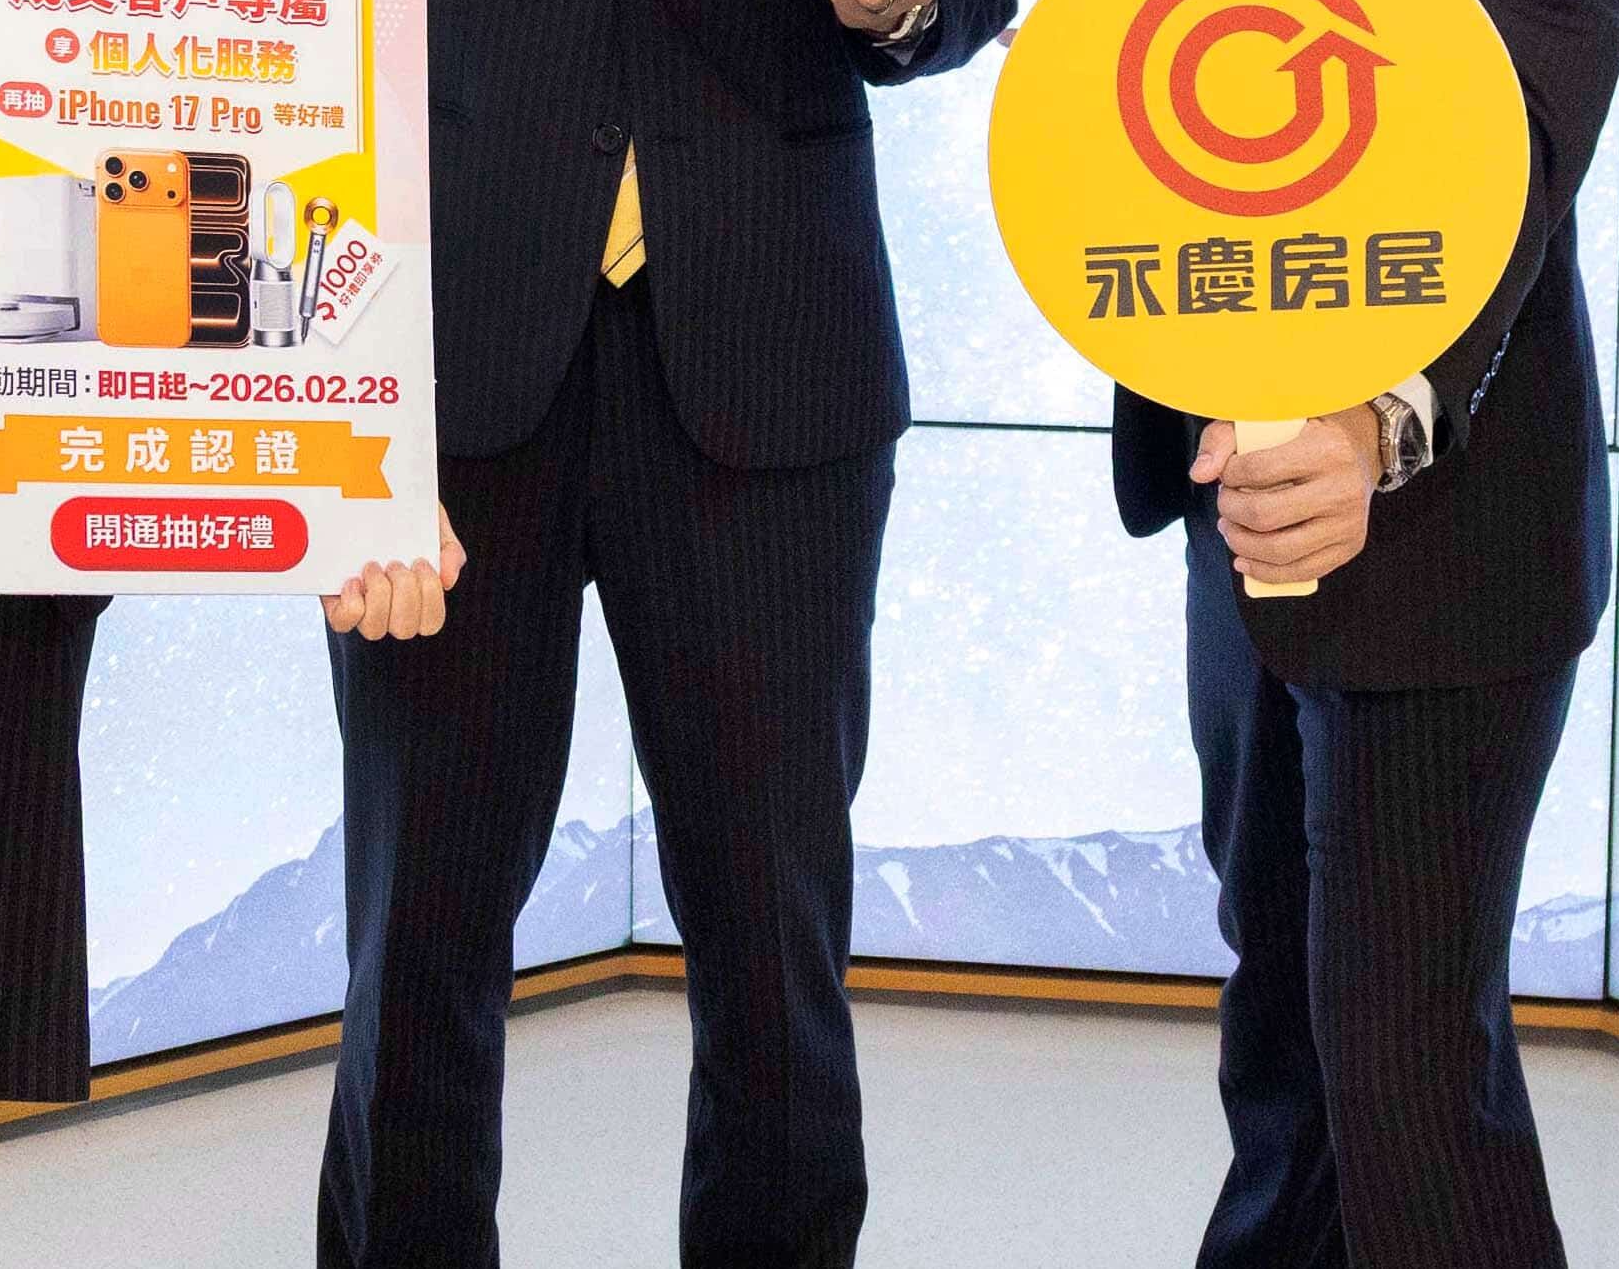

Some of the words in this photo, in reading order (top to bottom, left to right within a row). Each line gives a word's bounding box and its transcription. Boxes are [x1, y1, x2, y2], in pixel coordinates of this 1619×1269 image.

[52, 35, 73, 57] 享
[88, 30, 297, 80] 個人化服務
[1, 89, 47, 111] 再抽
[58, 90, 162, 127] iPhone
[170, 95, 201, 129] 17
[211, 100, 263, 131] Pro
[273, 101, 346, 129] 等好禮
[1084, 230, 1447, 319] 永慶房屋
[59, 425, 299, 476] 完成認證
[85, 513, 275, 550] 開通抽好禮
